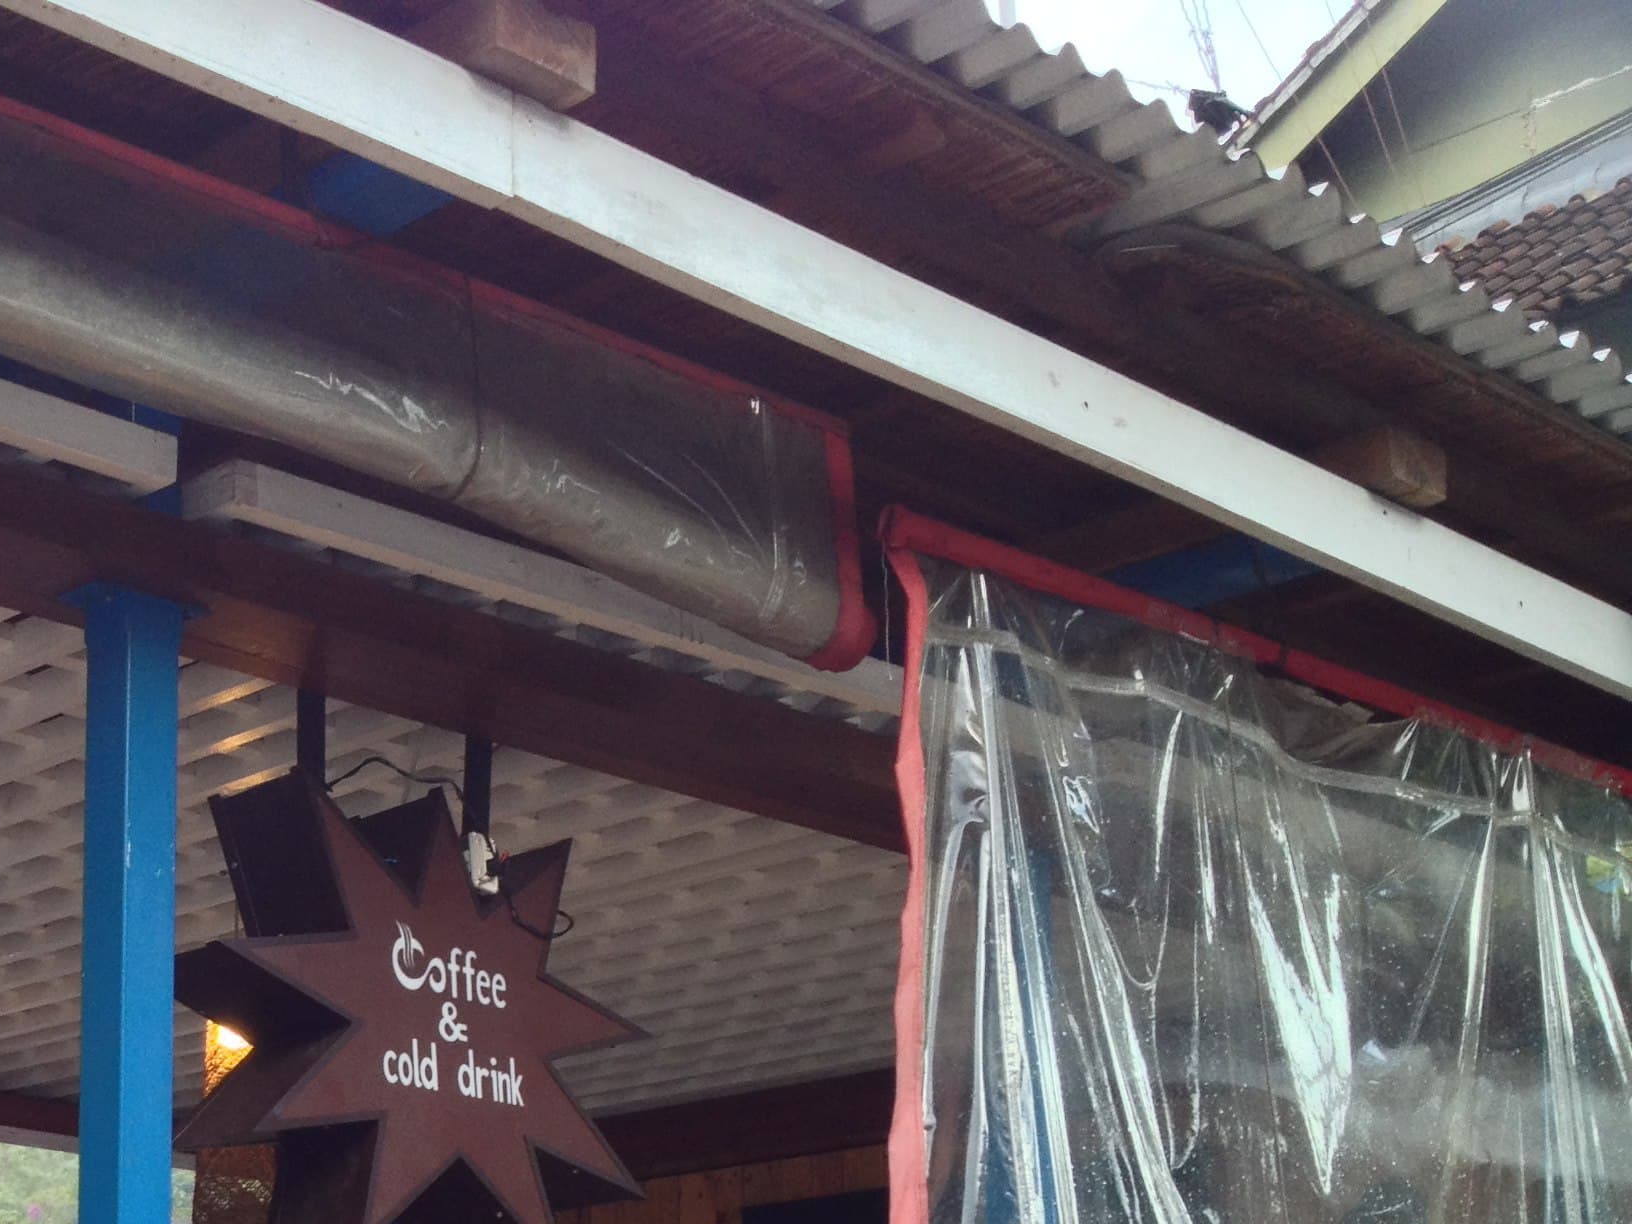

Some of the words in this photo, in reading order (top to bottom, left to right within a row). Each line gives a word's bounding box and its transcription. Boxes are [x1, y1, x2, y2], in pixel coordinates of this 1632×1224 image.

[392, 920, 506, 1008] Coffee
[438, 1001, 468, 1042] &
[383, 1038, 438, 1091] cold
[457, 1049, 524, 1107] drink
